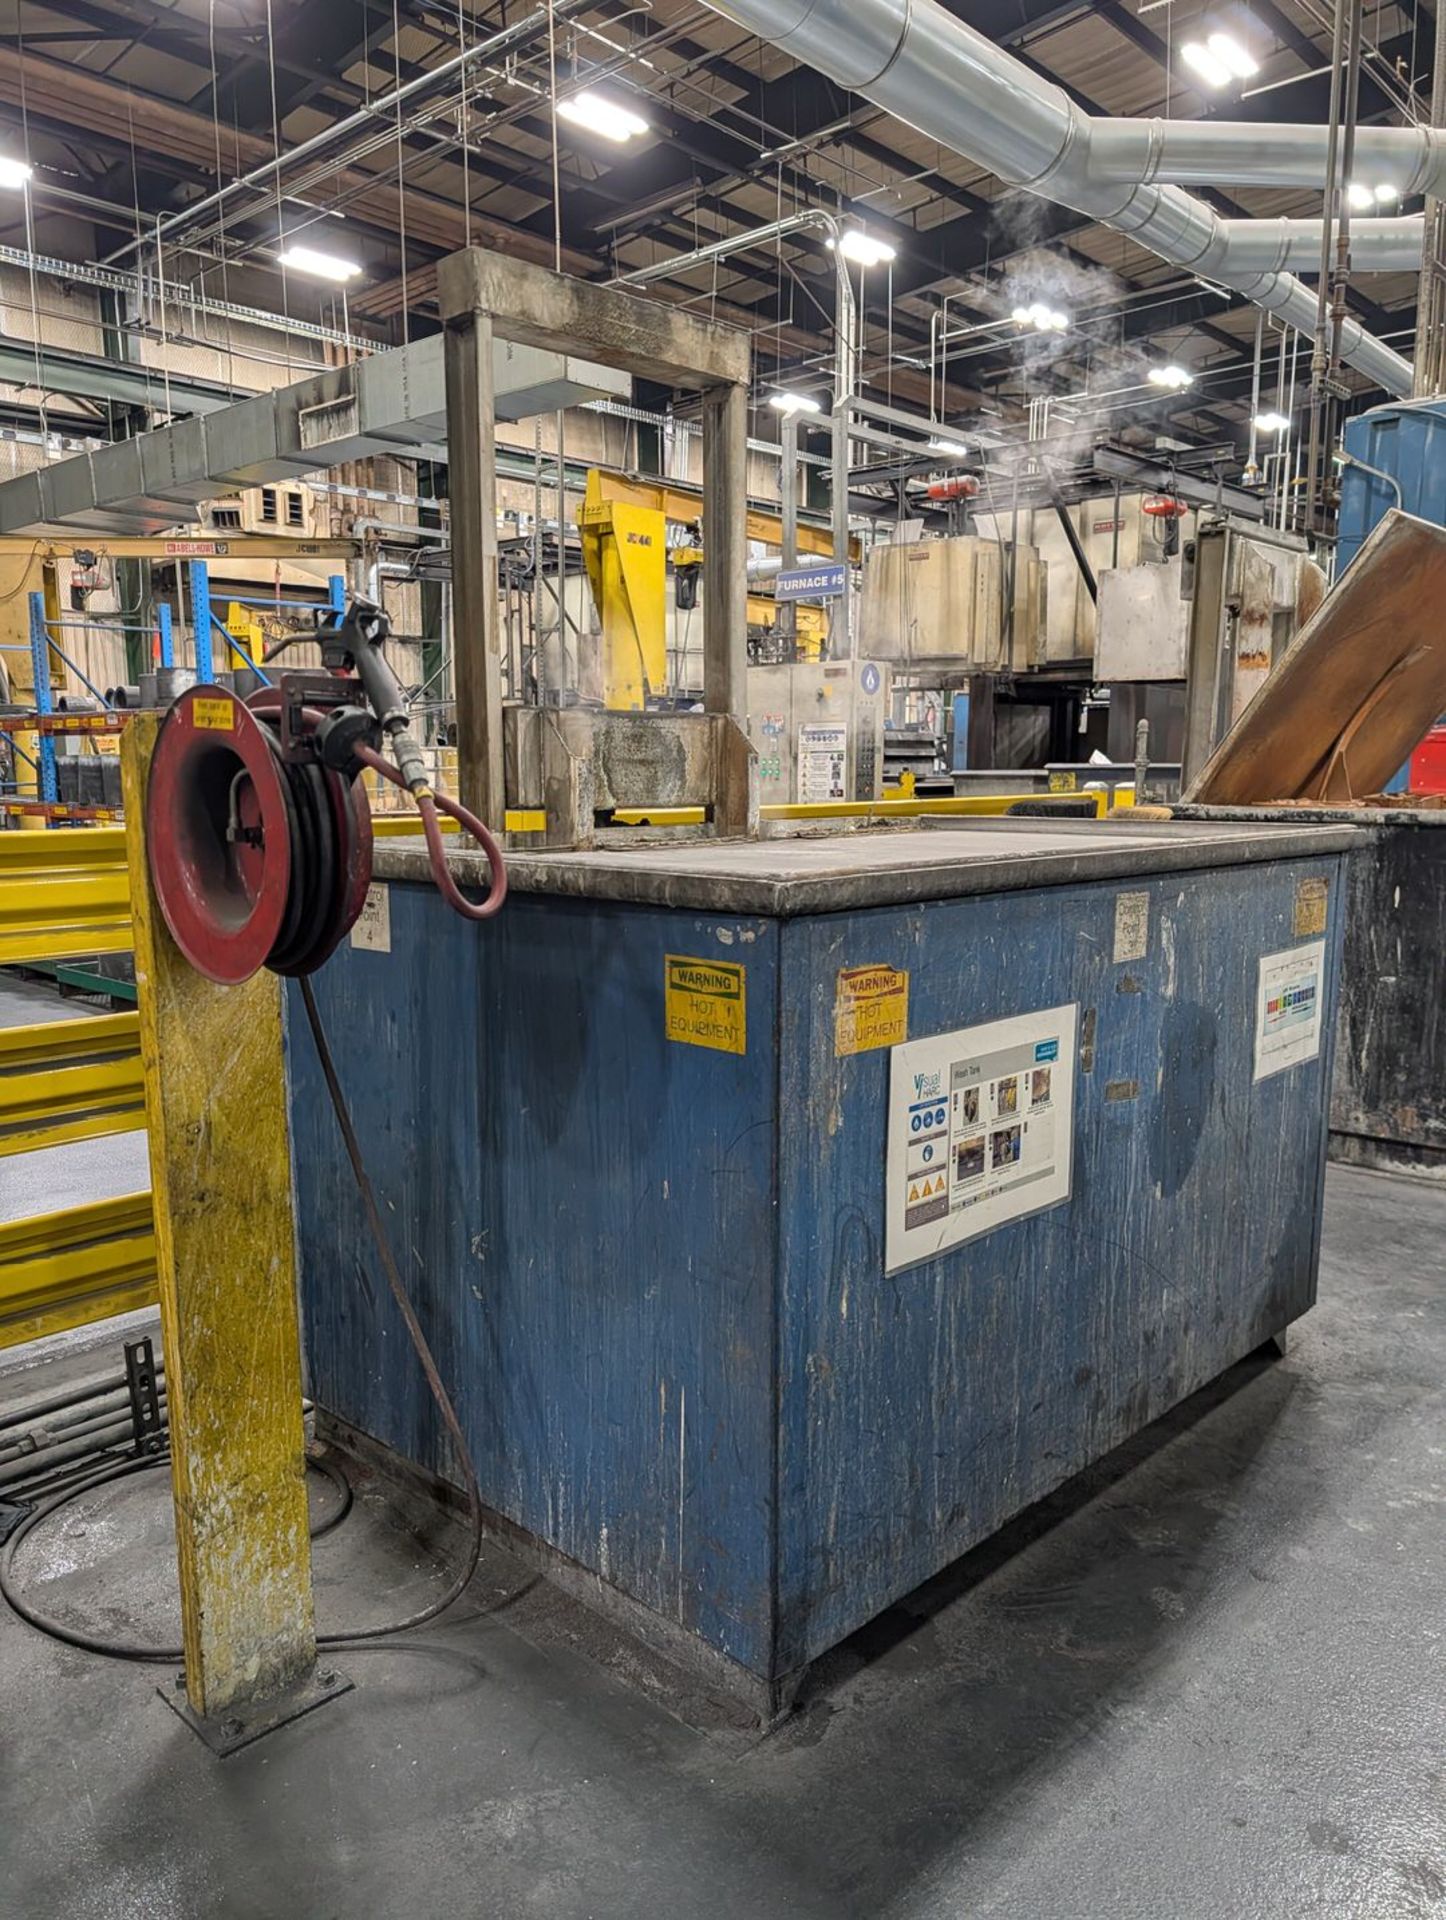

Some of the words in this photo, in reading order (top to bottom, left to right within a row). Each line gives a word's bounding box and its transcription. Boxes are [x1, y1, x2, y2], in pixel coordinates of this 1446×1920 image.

[777, 576, 828, 591] FURNACE
[678, 969, 731, 989] WARNING
[849, 975, 896, 992] WARNING
[689, 997, 715, 1016] HOT
[858, 1002, 882, 1020] HOT
[671, 1015, 741, 1042] EQUIPMENT
[840, 1020, 904, 1042] EQUIPMENT
